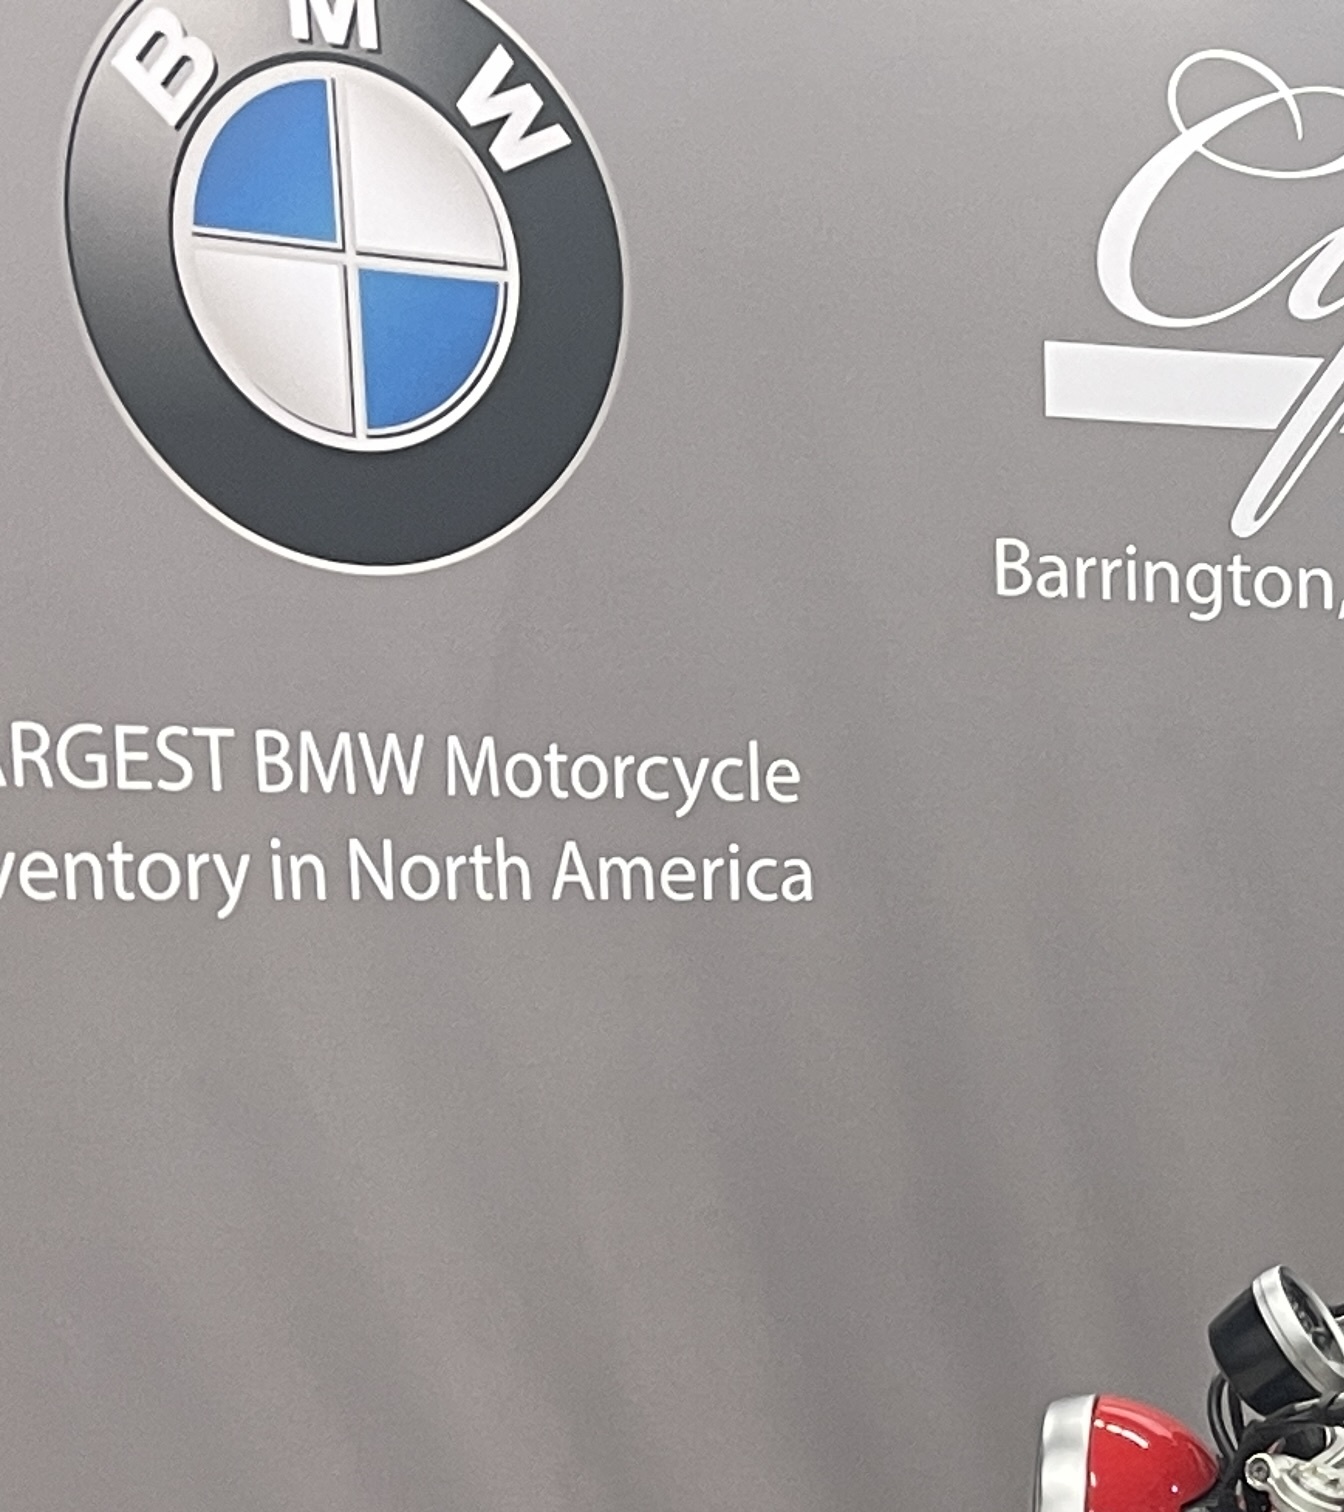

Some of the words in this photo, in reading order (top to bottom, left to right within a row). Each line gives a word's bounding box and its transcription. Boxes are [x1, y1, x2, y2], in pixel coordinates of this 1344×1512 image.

[0, 720, 235, 792] RGEST
[255, 728, 425, 796] BMW
[447, 734, 802, 818] Motorcycle
[270, 837, 327, 901] in
[348, 836, 532, 902] North
[551, 840, 814, 902] America
